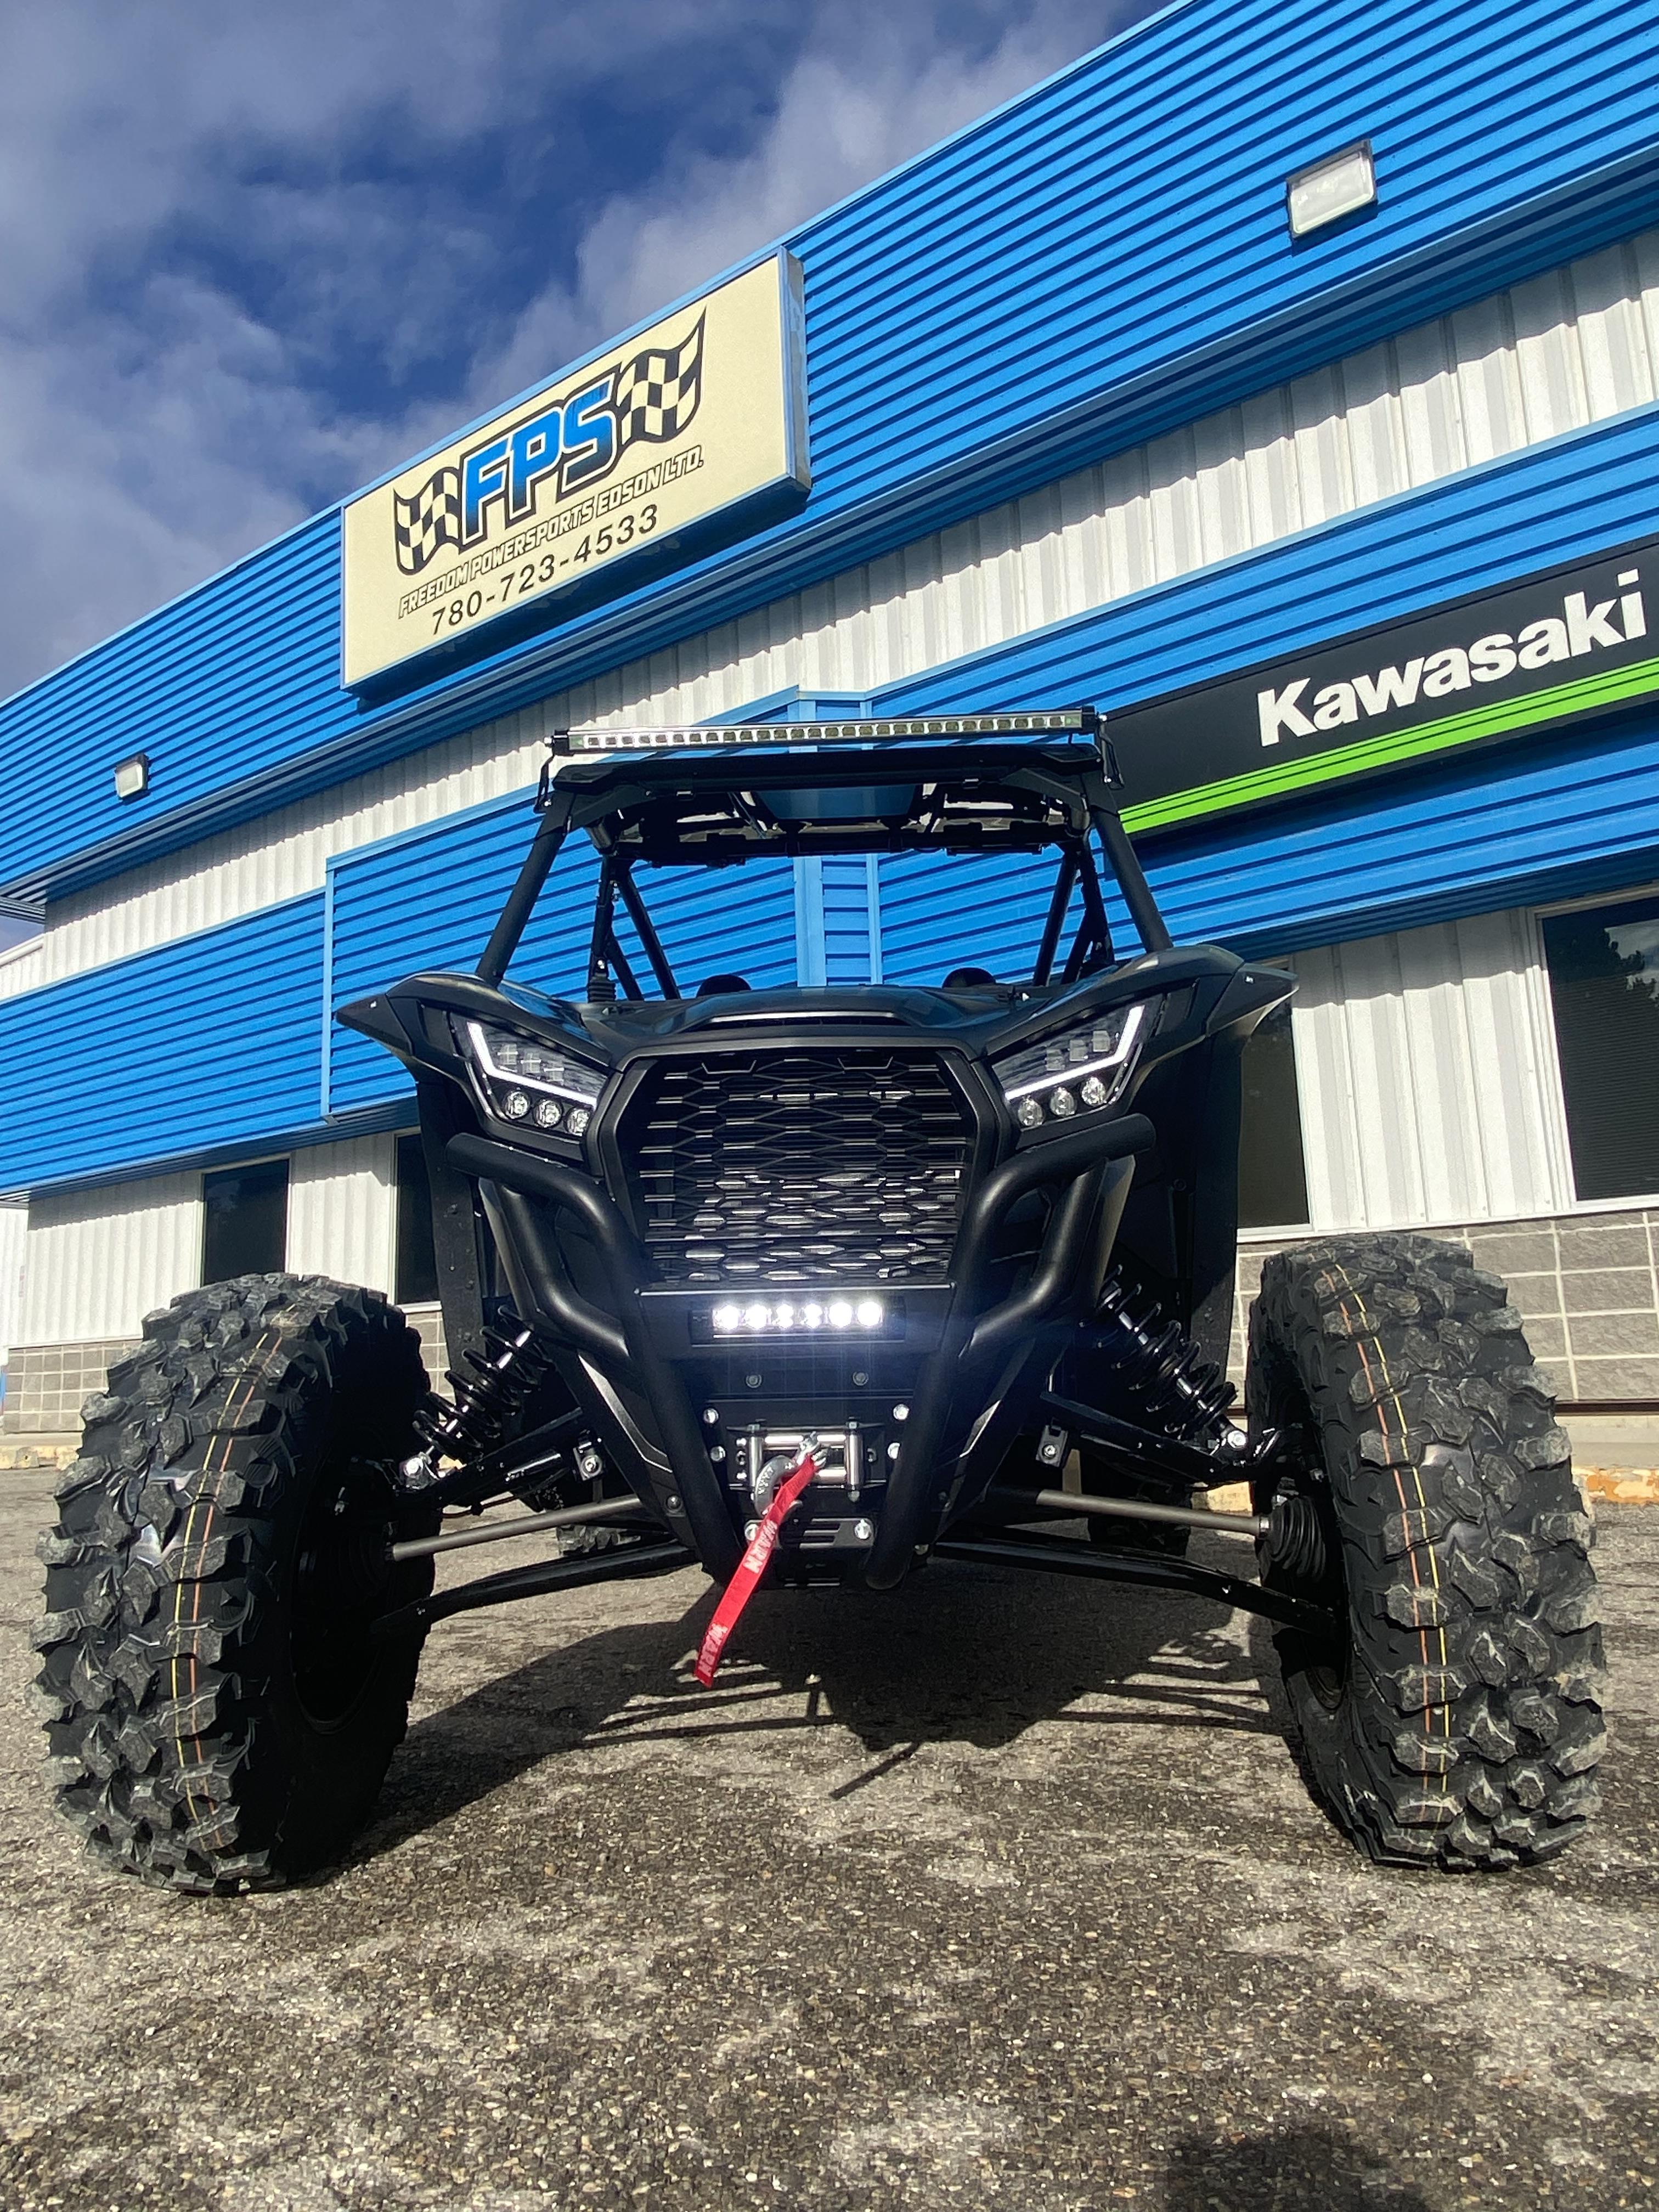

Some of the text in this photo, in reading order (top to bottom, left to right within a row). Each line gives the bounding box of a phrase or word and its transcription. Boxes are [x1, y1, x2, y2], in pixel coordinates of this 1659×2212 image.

[398, 444, 704, 619] FREEDOM POWERSPORTS EDSON LTD.
[460, 370, 618, 549] FPS
[432, 504, 657, 635] 780-723-4533
[1257, 568, 1646, 747] Kawasaki
[742, 1519, 777, 1574] WARN
[697, 1623, 729, 1678] WARN
